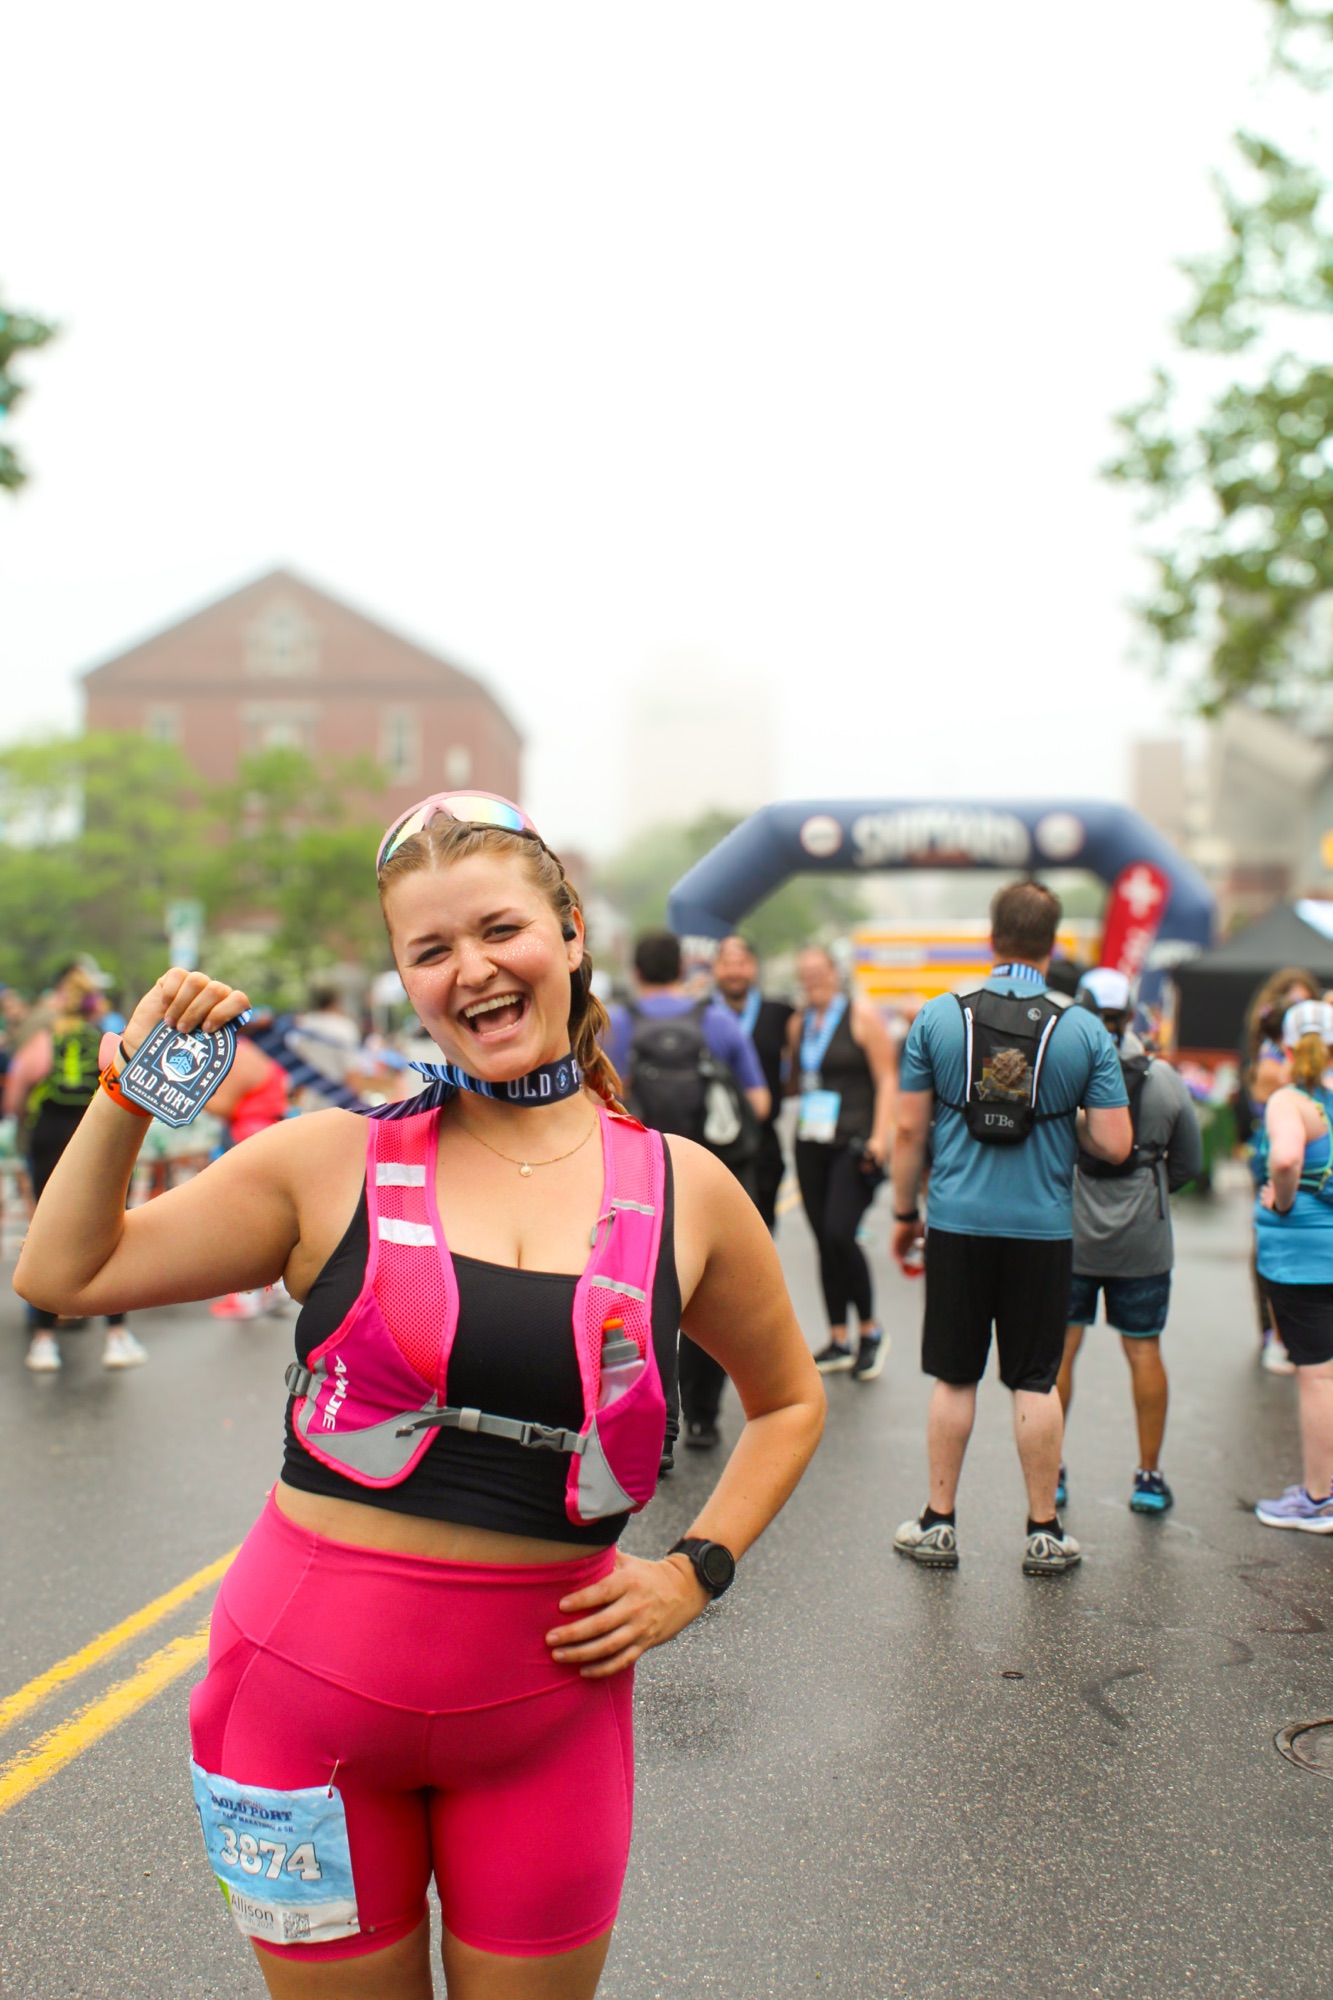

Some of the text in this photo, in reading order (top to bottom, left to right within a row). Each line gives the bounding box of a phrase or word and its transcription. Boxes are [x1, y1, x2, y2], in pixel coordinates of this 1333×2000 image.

[130, 1064, 195, 1113] OLD PORT
[507, 1074, 551, 1099] OLD
[250, 1807, 292, 1821] PORT
[218, 1824, 322, 1881] 3874
[231, 1894, 274, 1922] Allison
